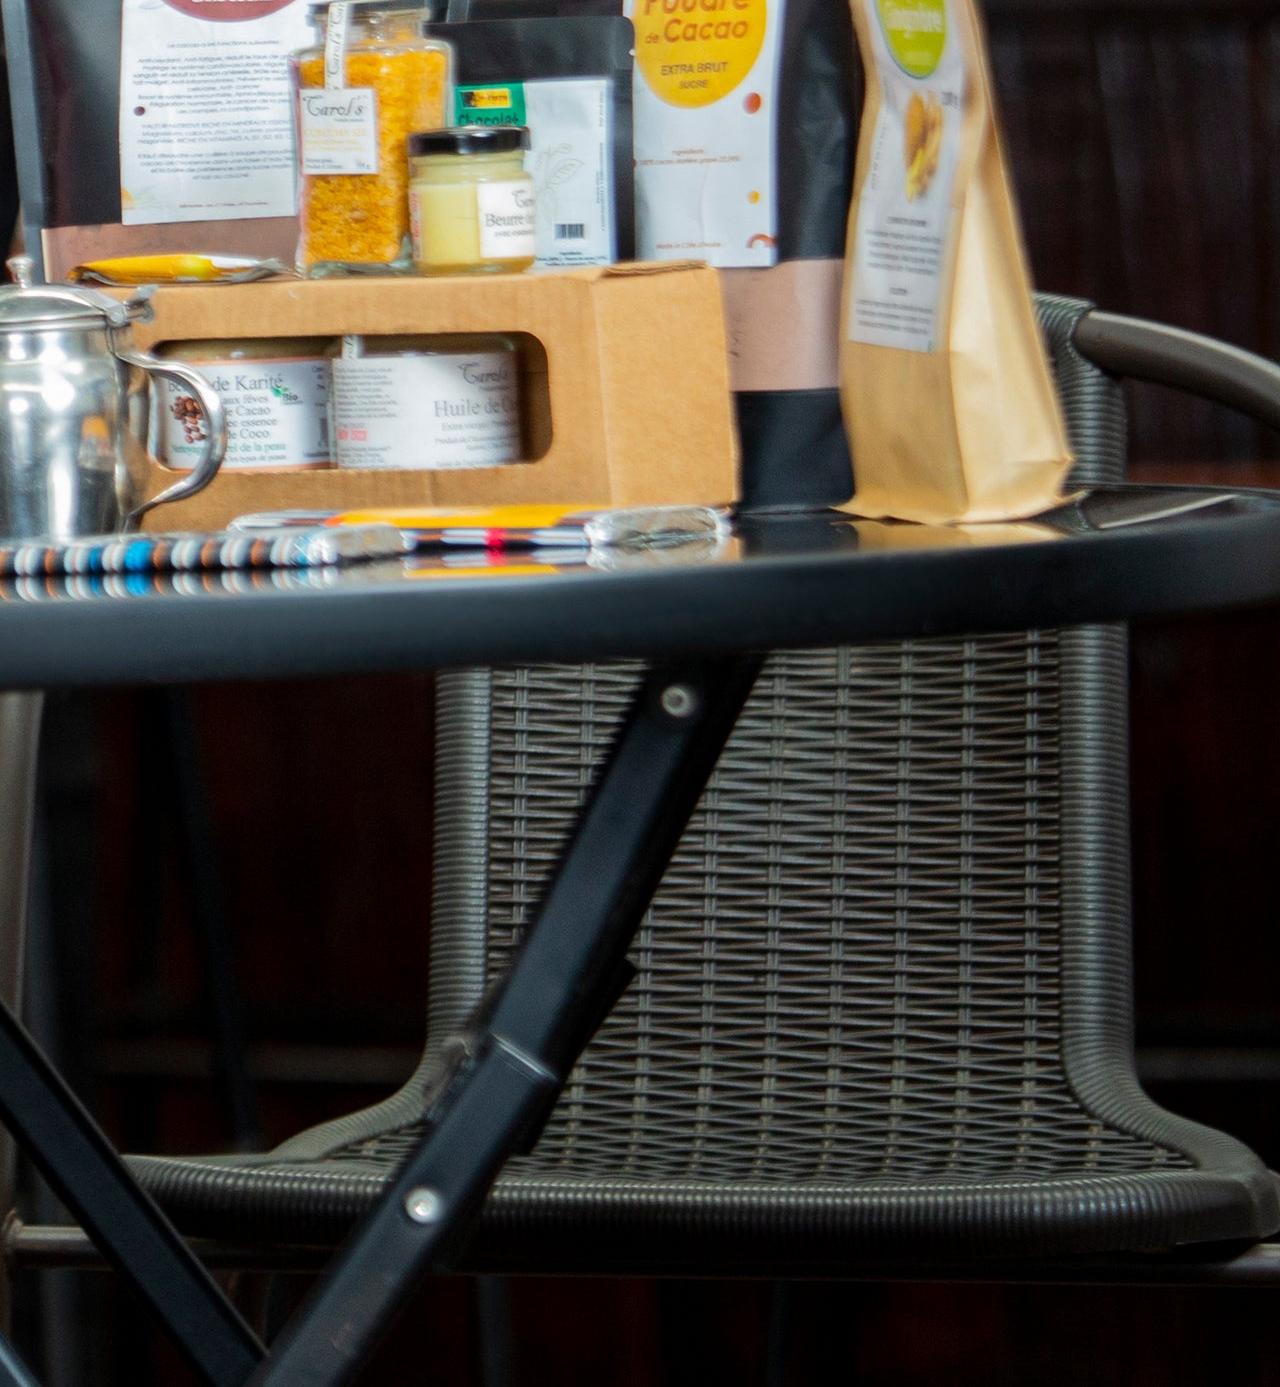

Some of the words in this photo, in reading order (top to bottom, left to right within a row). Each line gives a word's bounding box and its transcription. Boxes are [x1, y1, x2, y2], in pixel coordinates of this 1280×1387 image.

[645, 32, 659, 44] de
[664, 18, 749, 43] Cacao
[660, 64, 695, 76] EXTRA
[697, 62, 729, 74] BRUT
[679, 80, 708, 89] SUCRE
[484, 214, 525, 228] Beurre
[235, 373, 283, 391] Karité
[236, 405, 271, 416] Cacao
[433, 398, 480, 418] Huile
[484, 397, 500, 414] de
[239, 428, 270, 440] Coco
